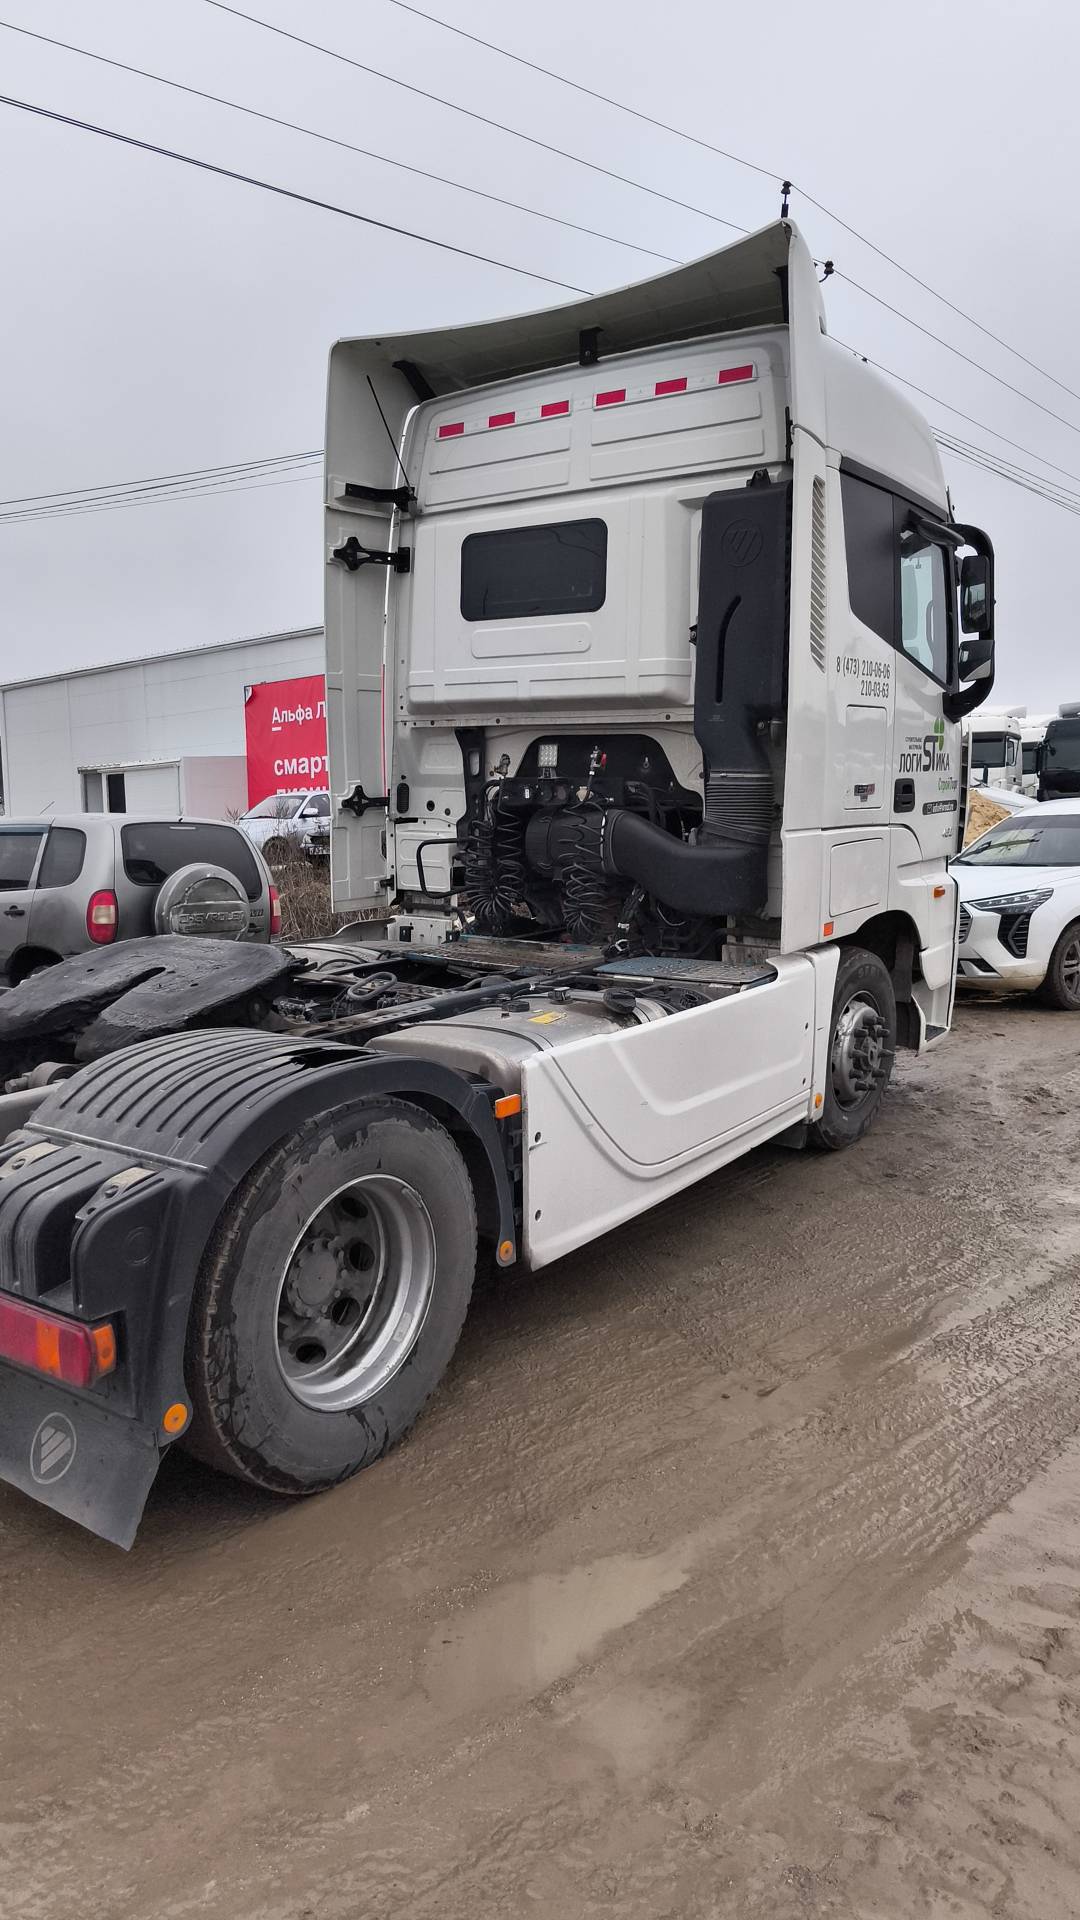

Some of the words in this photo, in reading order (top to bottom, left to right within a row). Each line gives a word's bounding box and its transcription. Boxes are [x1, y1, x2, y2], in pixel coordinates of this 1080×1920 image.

[836, 655, 841, 673] 8
[842, 656, 860, 678] (473)
[860, 679, 890, 699] 210-03-63
[271, 704, 313, 725] Альфа
